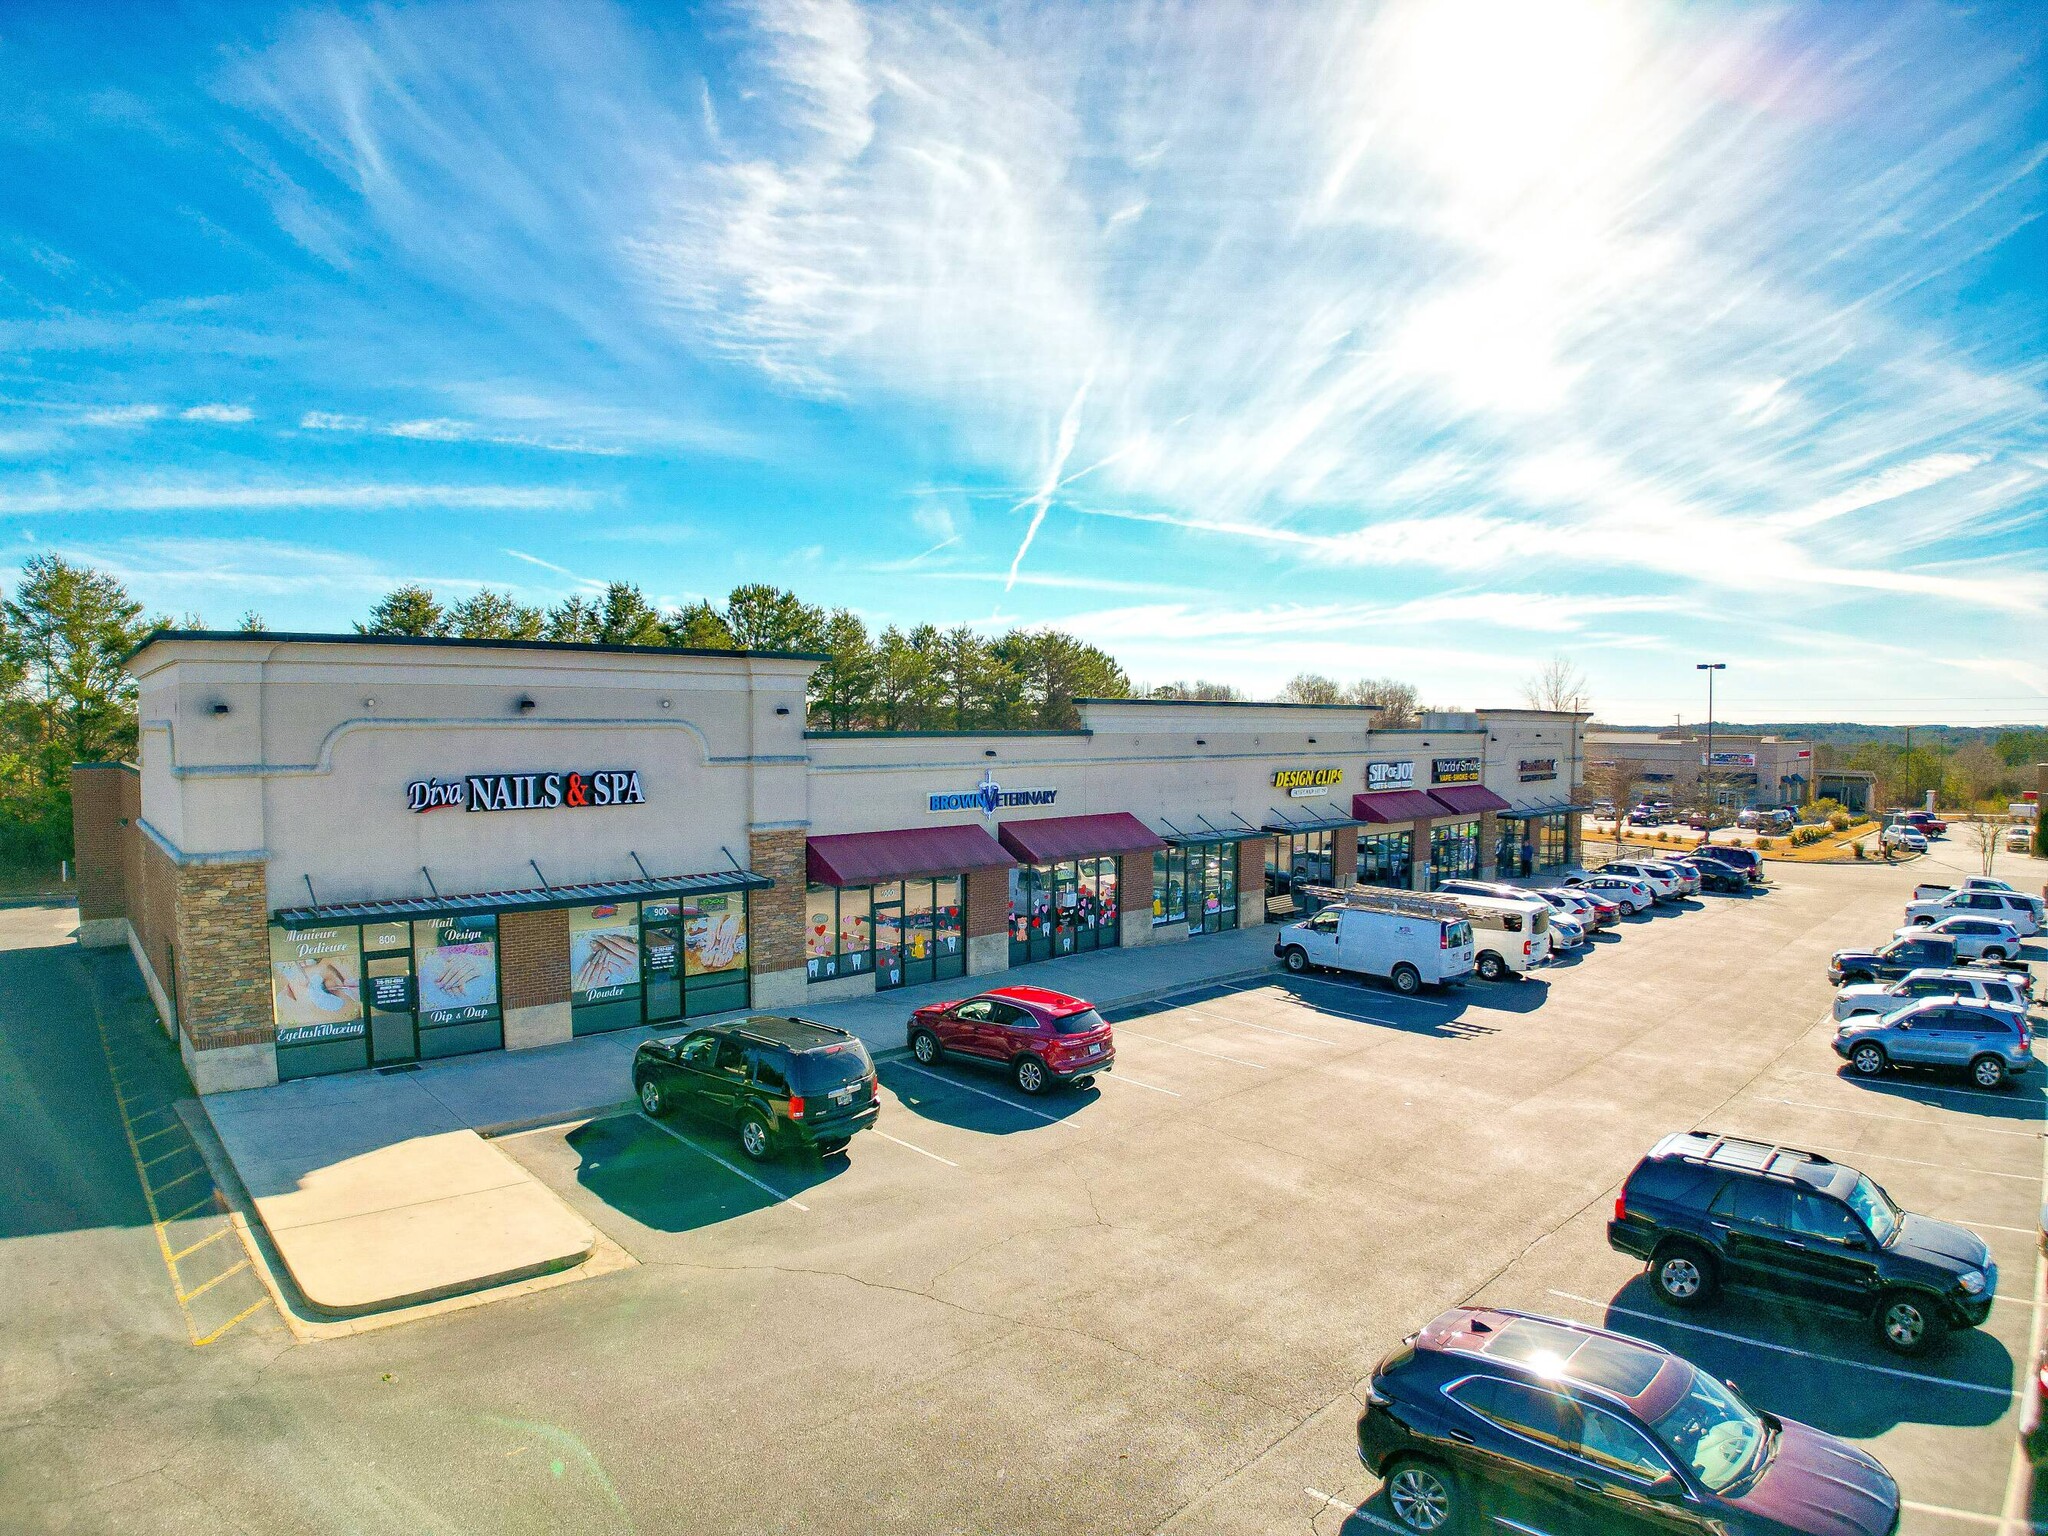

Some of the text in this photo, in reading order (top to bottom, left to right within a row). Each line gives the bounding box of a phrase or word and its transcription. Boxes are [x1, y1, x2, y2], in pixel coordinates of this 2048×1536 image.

[1276, 768, 1343, 787] DESIGN CLIPS
[1369, 764, 1389, 781] SIP
[1395, 762, 1415, 780] JOY
[409, 771, 646, 811] Diva NAILS & SPA
[929, 785, 1058, 812] BROWN VETERINARY
[654, 907, 669, 917] 900
[427, 917, 454, 928] Nail
[285, 929, 338, 942] Manicure
[379, 935, 396, 944] 800
[444, 929, 482, 941] Design
[296, 942, 349, 957] Pedicure
[585, 986, 625, 1002] Powder
[430, 1011, 453, 1023] Dip
